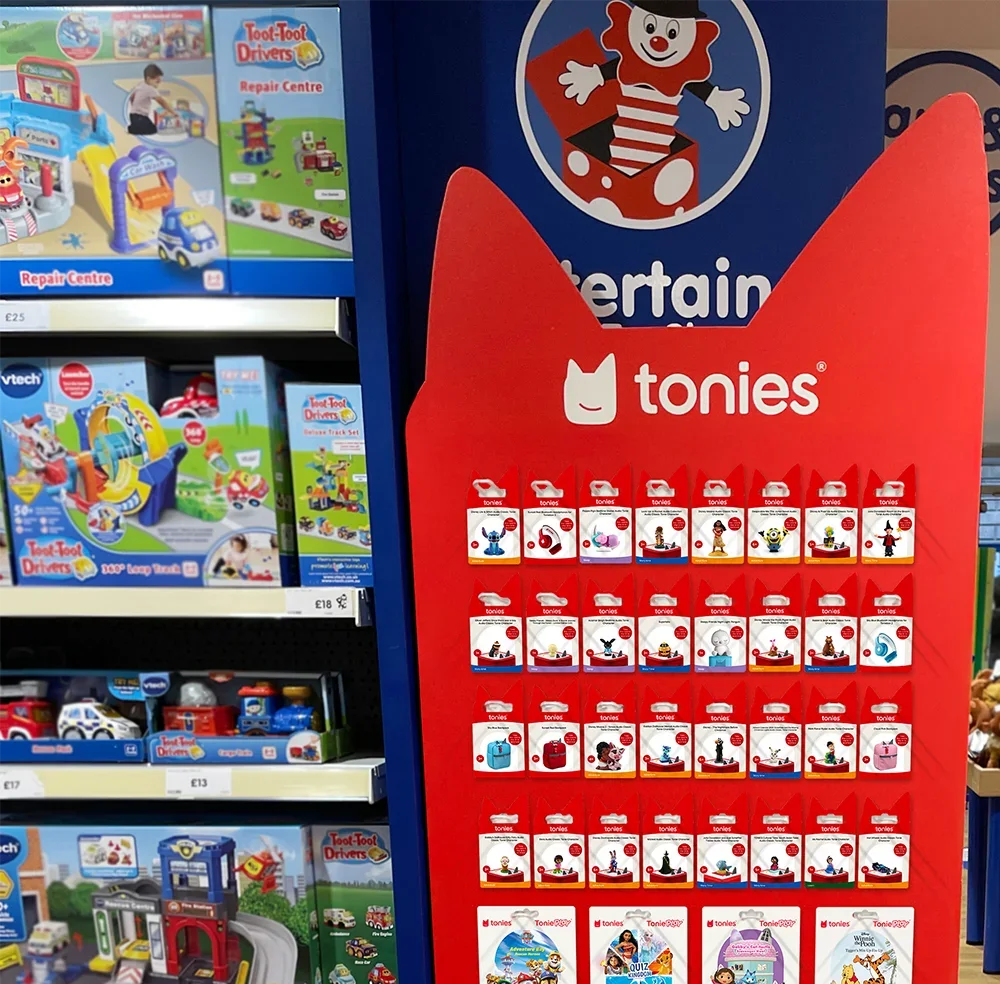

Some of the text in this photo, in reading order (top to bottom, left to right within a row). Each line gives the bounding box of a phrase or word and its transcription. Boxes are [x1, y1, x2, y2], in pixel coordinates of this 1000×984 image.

[243, 21, 307, 42] Toot-Toot
[236, 42, 293, 63] Drivers
[239, 80, 324, 96] Repair Centre
[20, 271, 113, 289] Repair Centre
[5, 312, 25, 323] £25
[1, 371, 41, 386] vtech
[309, 396, 346, 408] Toot-Toot
[304, 408, 339, 420] Drivers
[27, 540, 82, 557] Toot-Toot
[21, 557, 71, 575] Drivers
[315, 599, 332, 609] £18
[143, 681, 166, 690] vtech
[161, 736, 196, 747] Toot-Toot
[157, 747, 189, 758] Drivers
[4, 780, 20, 790] £17
[191, 778, 208, 788] £13
[328, 832, 377, 846] Toot-Toot
[323, 846, 367, 860] Drivers
[630, 962, 649, 972] QUIZ
